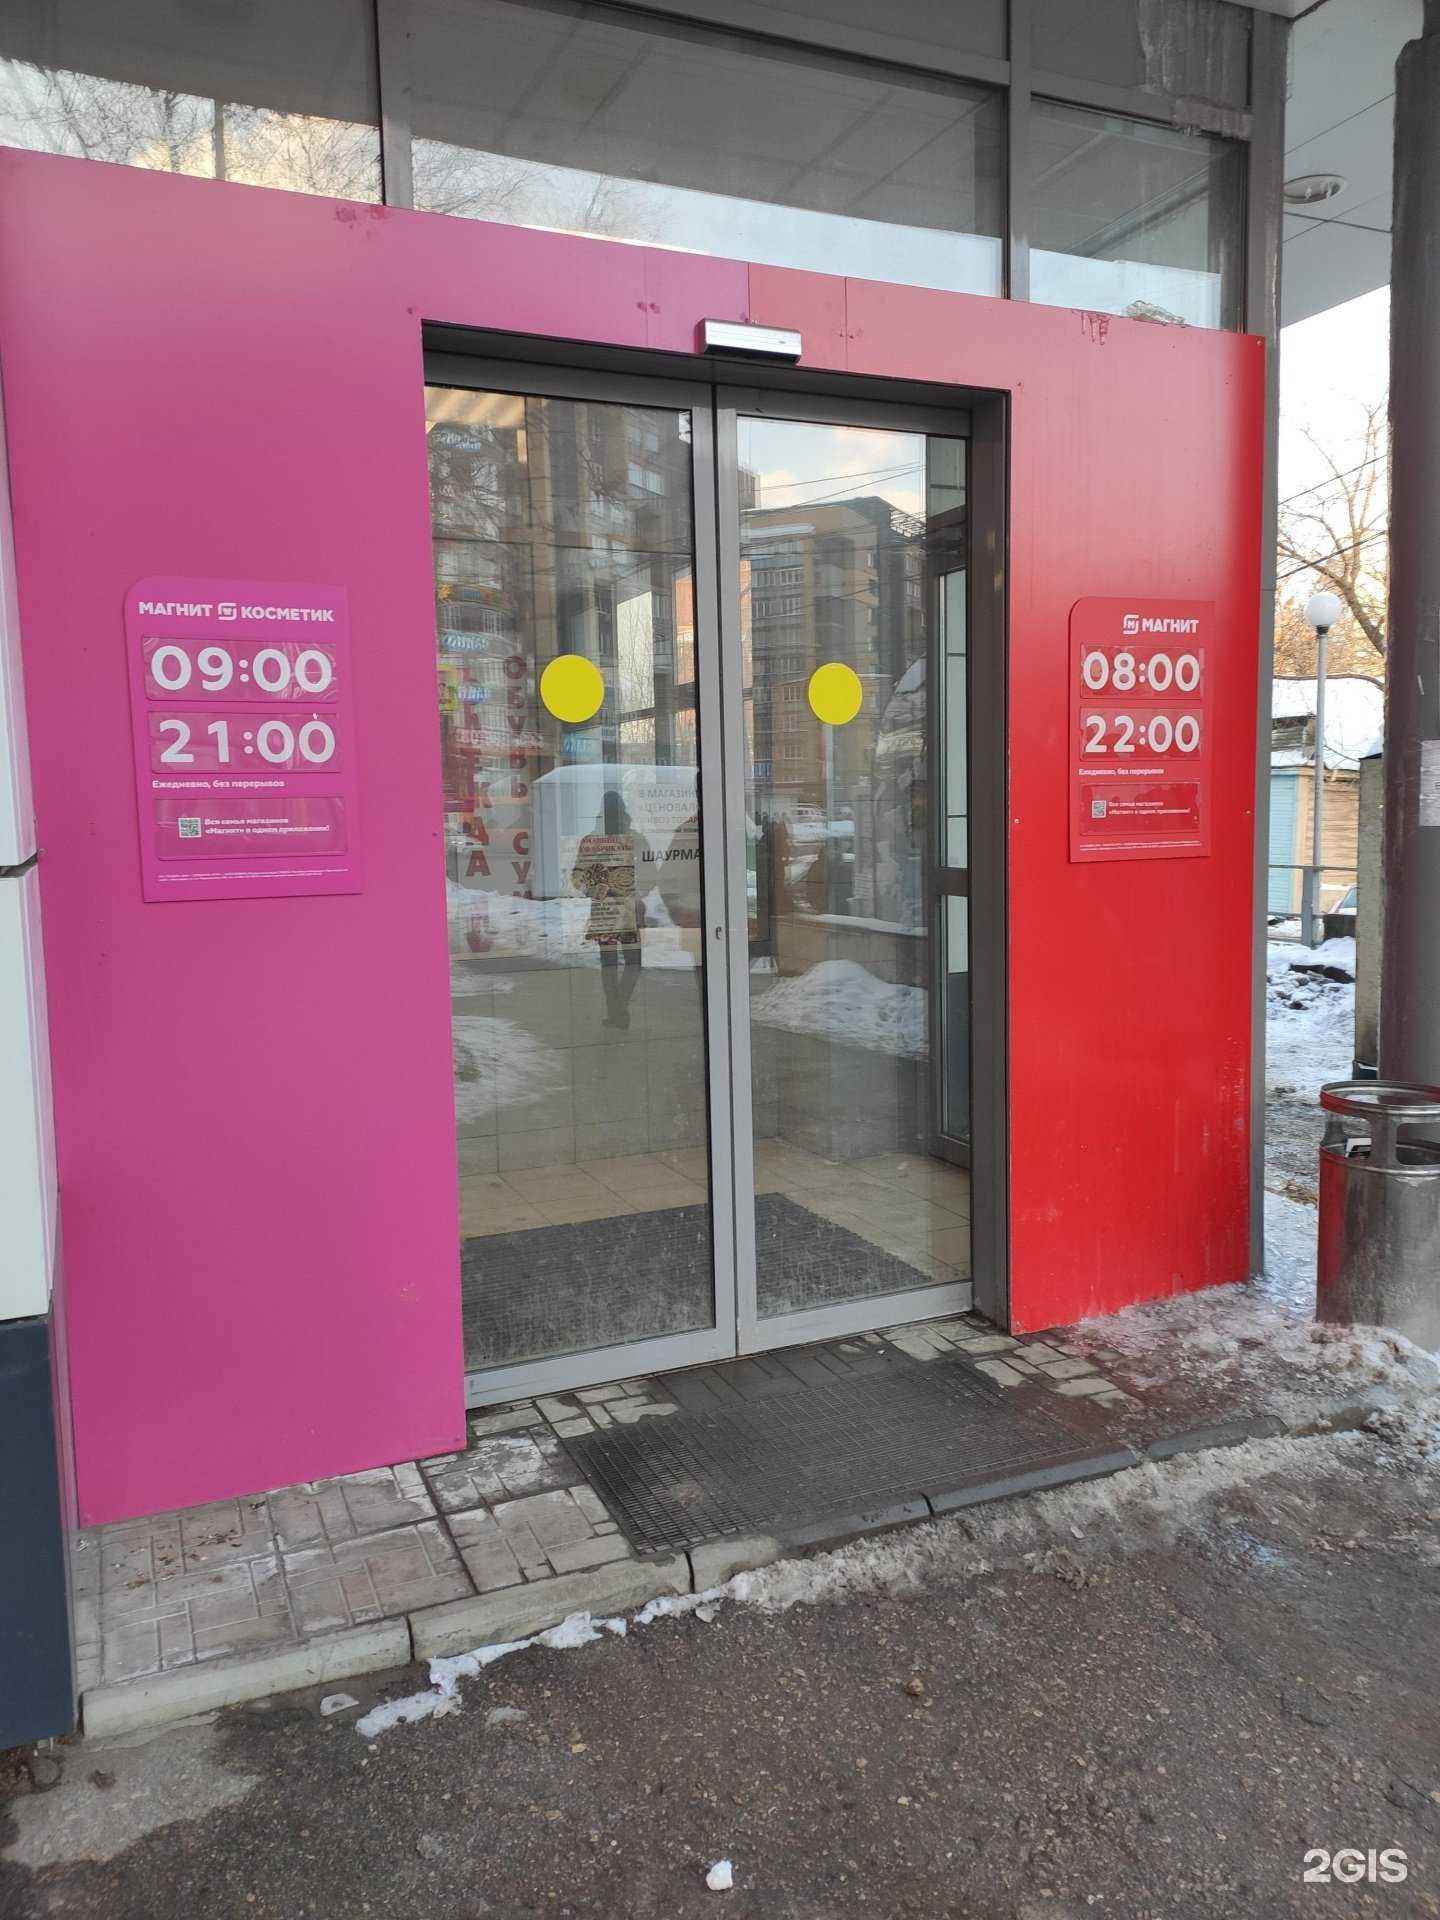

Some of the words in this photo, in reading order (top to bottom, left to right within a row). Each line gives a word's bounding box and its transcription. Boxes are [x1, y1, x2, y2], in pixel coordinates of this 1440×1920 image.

[138, 601, 214, 617] МАГНИТ
[240, 606, 335, 623] КОСМЕТИК
[1141, 617, 1200, 634] МАГНИТ
[150, 645, 333, 693] 09:00
[1083, 651, 1200, 692] 08:00
[159, 719, 336, 763] 21:00
[1085, 715, 1200, 753] 22:00
[152, 780, 211, 790] Ежедневно,
[213, 779, 230, 788] без
[231, 780, 285, 789] перерывов
